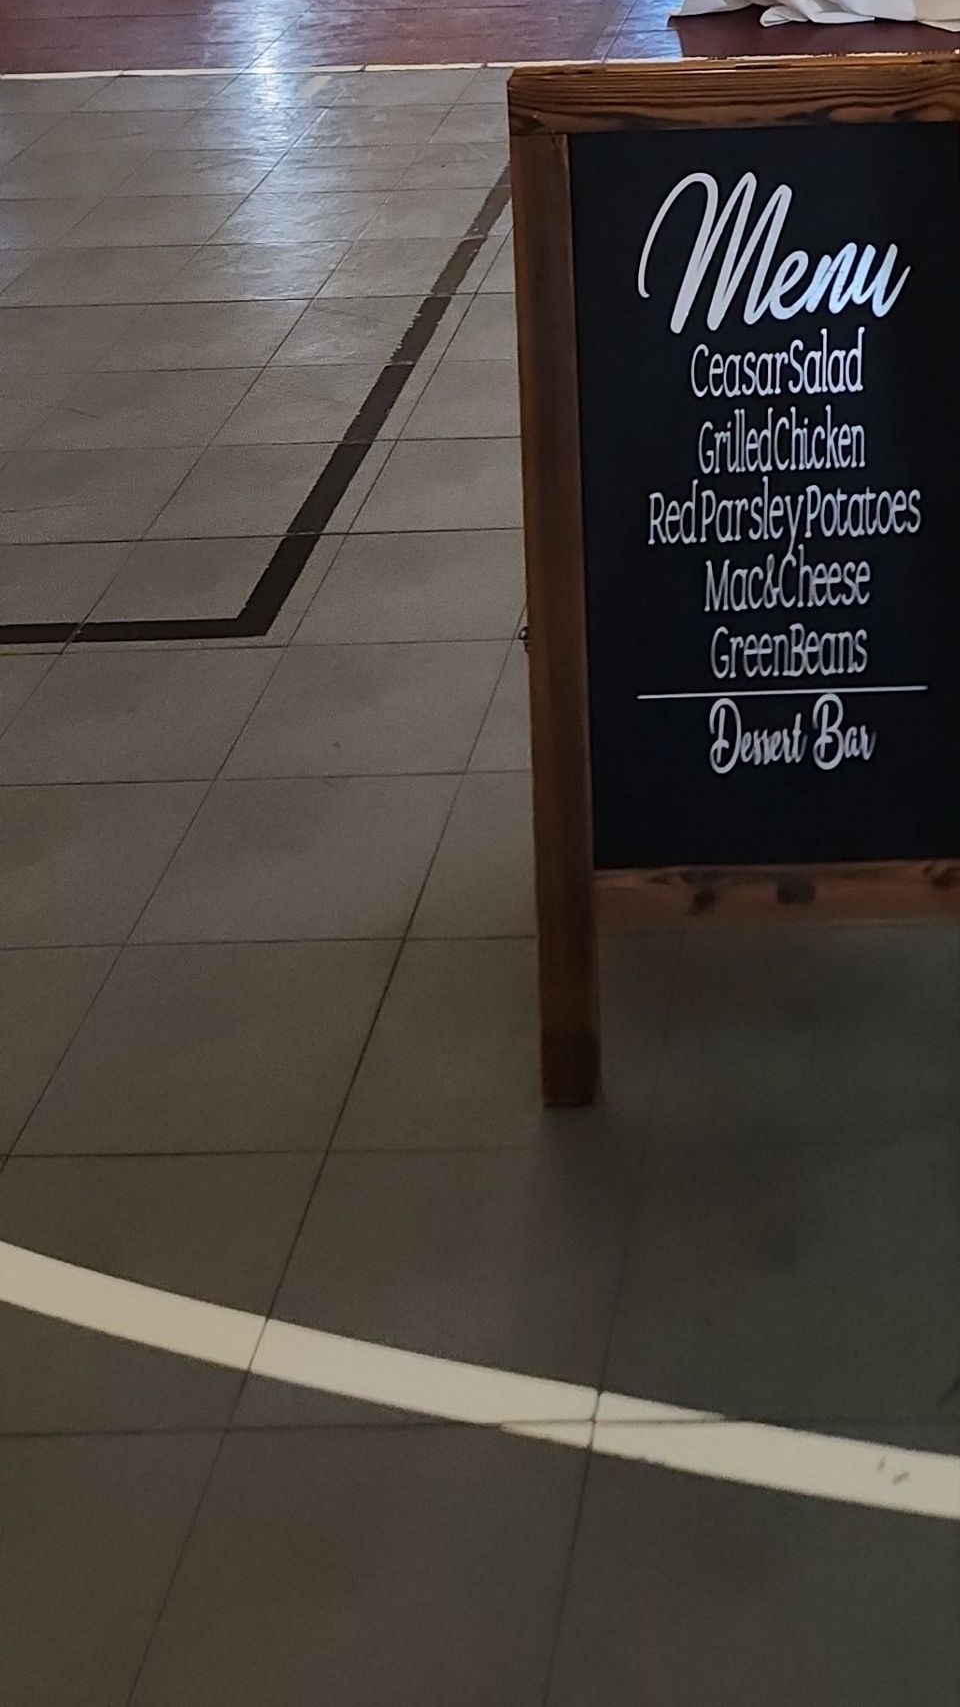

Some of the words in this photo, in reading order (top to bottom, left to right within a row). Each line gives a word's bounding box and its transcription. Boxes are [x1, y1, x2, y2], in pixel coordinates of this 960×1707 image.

[637, 171, 911, 334] Menu
[708, 697, 808, 774] Dessert
[812, 693, 877, 771] Bar
